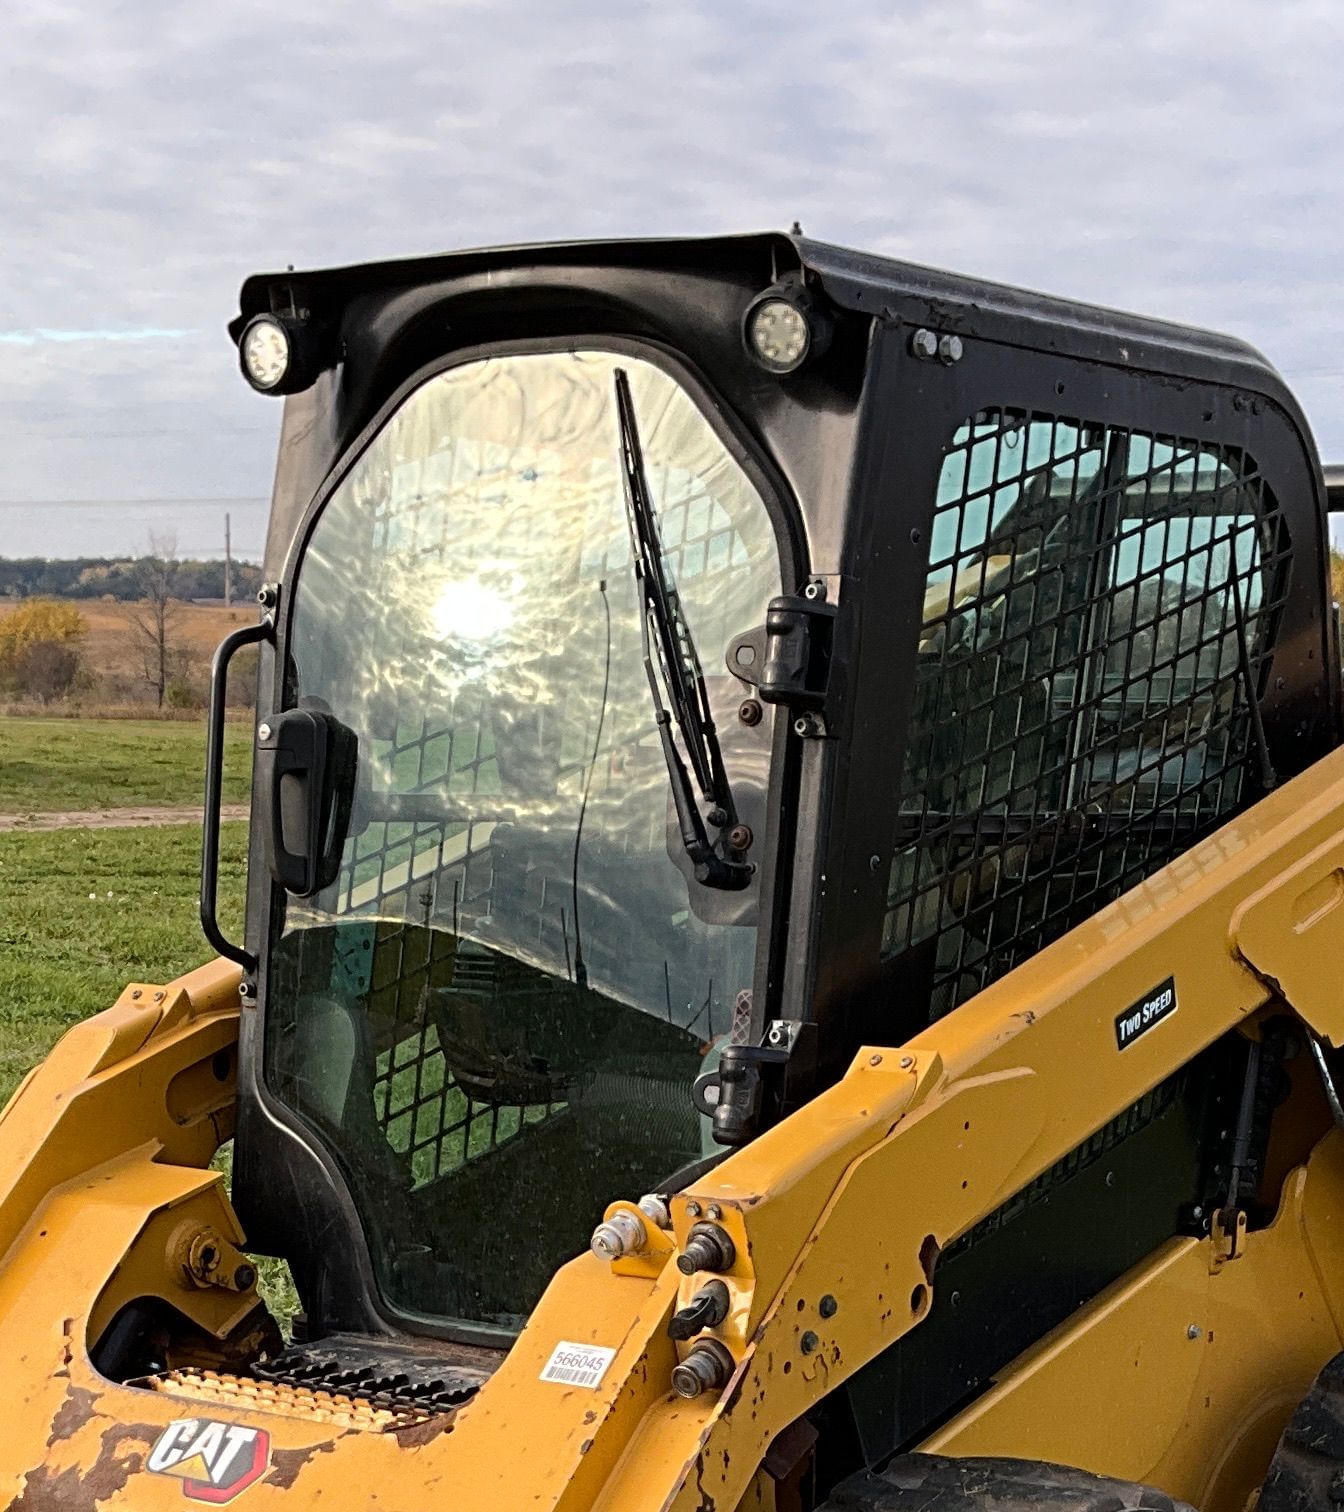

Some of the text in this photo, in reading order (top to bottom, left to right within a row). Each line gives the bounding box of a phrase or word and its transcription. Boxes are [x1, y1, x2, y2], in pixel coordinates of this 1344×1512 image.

[1119, 989, 1172, 1041] TWO SPEED
[553, 1351, 605, 1371] 566045
[150, 1418, 258, 1484] CAT
